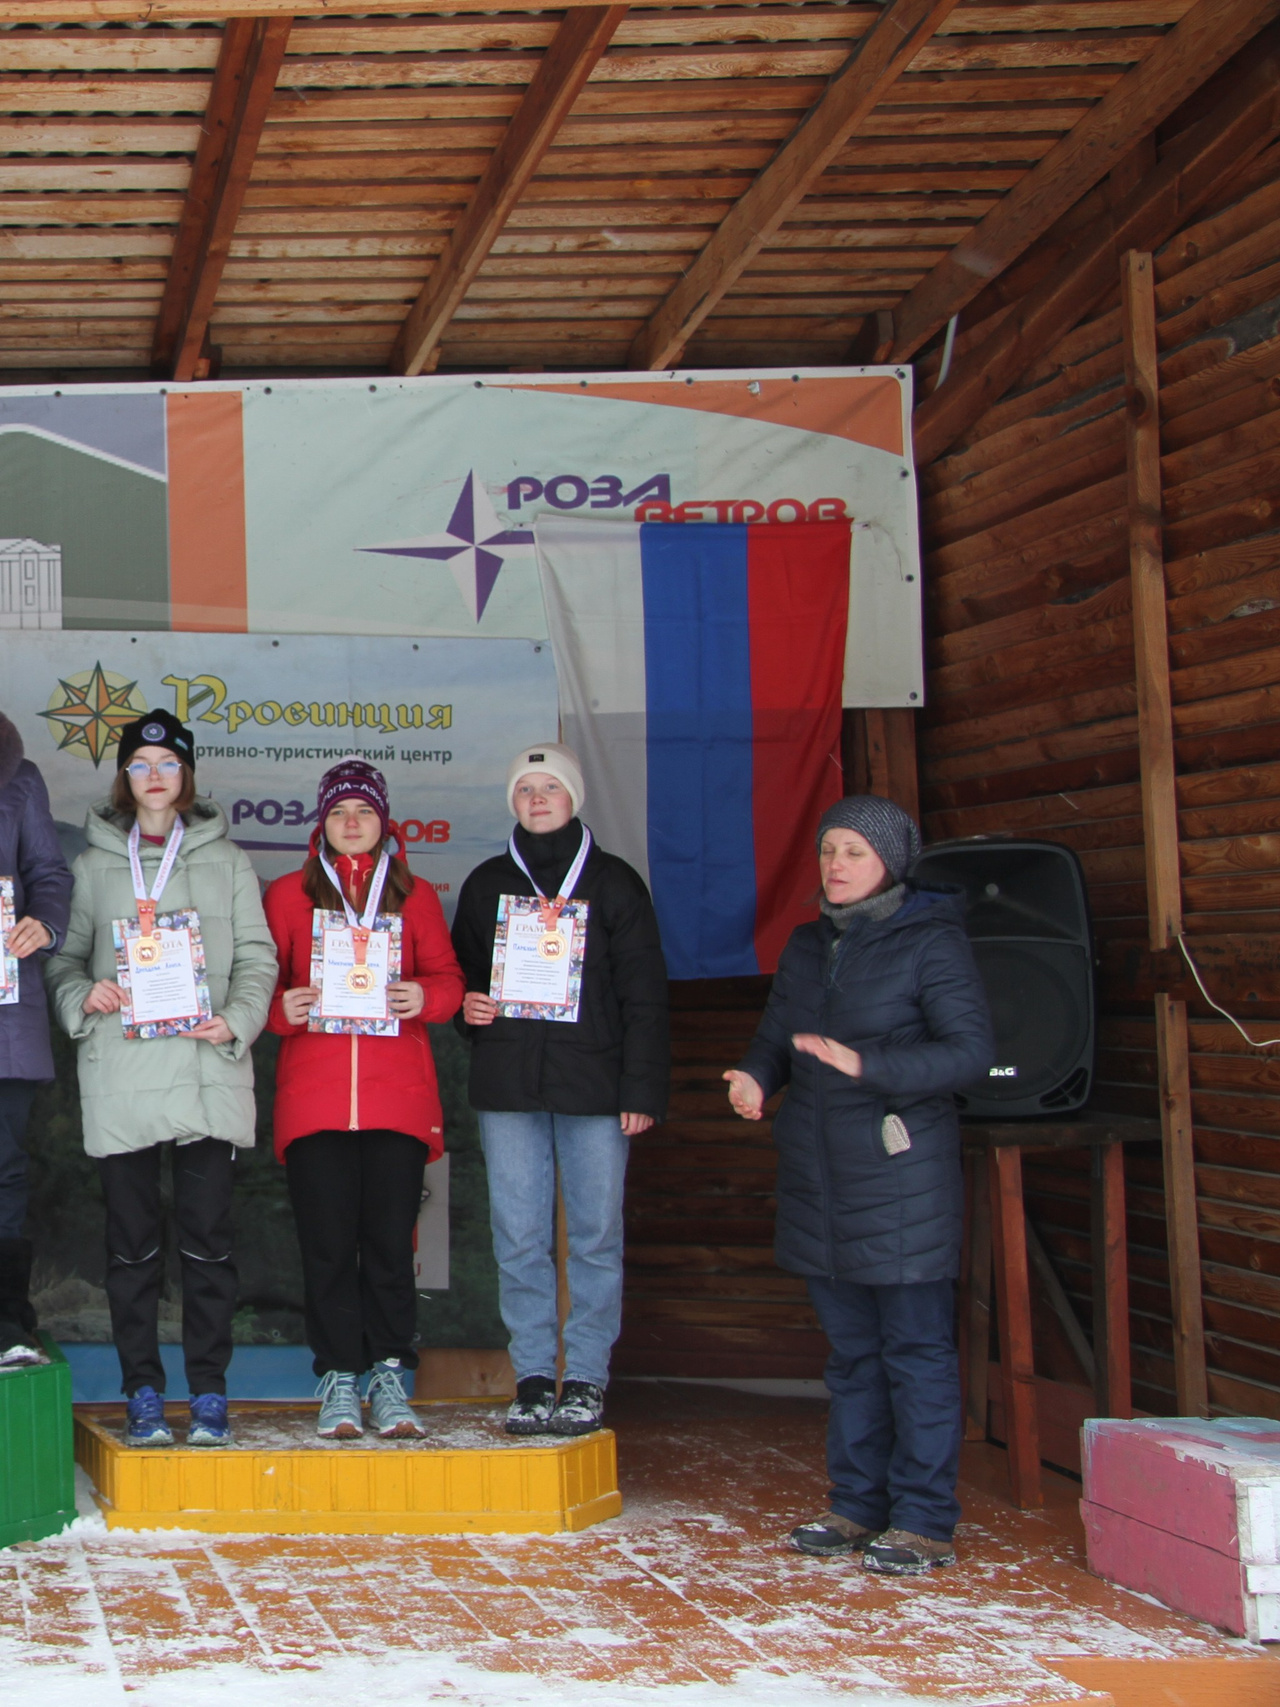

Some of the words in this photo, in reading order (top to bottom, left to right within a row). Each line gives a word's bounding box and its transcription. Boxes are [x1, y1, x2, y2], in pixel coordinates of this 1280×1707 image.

[507, 473, 670, 510] РОЗА
[161, 674, 452, 734] Провинция
[400, 748, 452, 764] центр
[989, 1067, 1015, 1077] B&G
